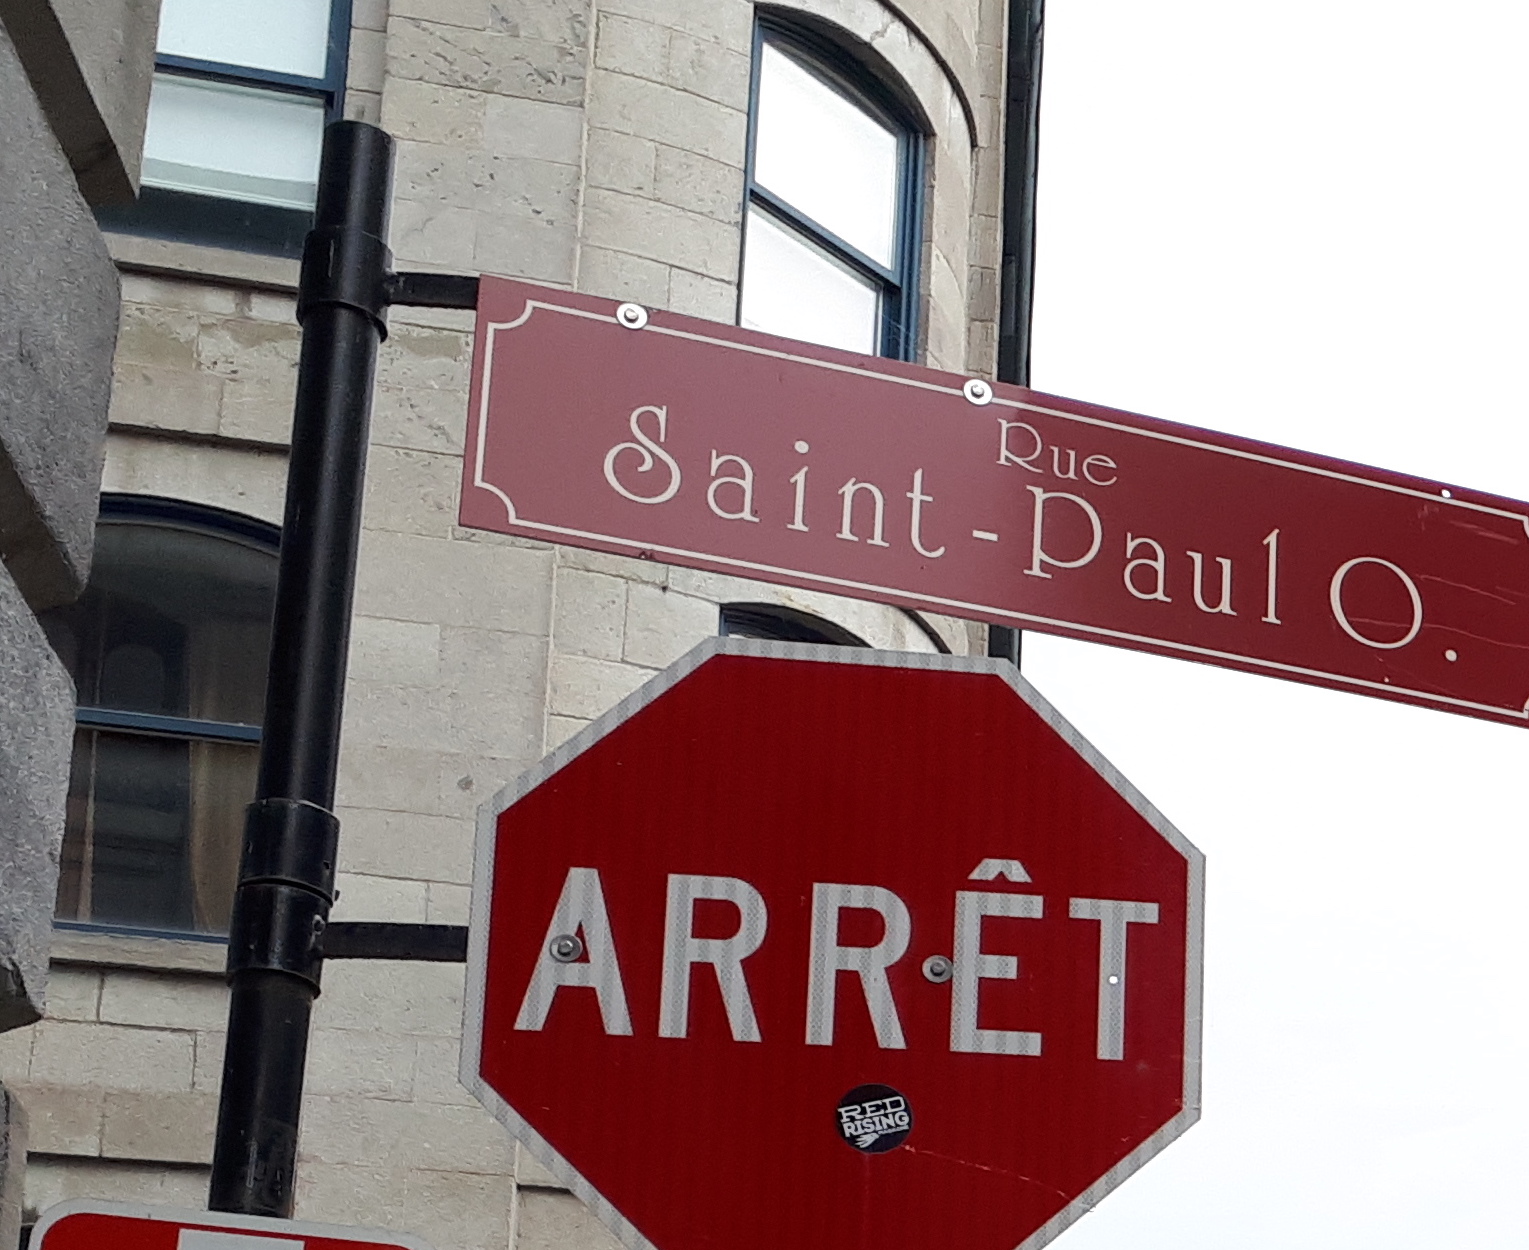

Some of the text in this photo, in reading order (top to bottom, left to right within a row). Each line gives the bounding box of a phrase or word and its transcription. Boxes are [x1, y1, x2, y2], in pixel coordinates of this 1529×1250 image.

[996, 417, 1119, 487] Rue
[603, 405, 1460, 663] Saint-Paul O.
[513, 857, 1160, 1062] ARRÊT
[837, 1096, 906, 1123] RED
[843, 1111, 909, 1138] RISING
